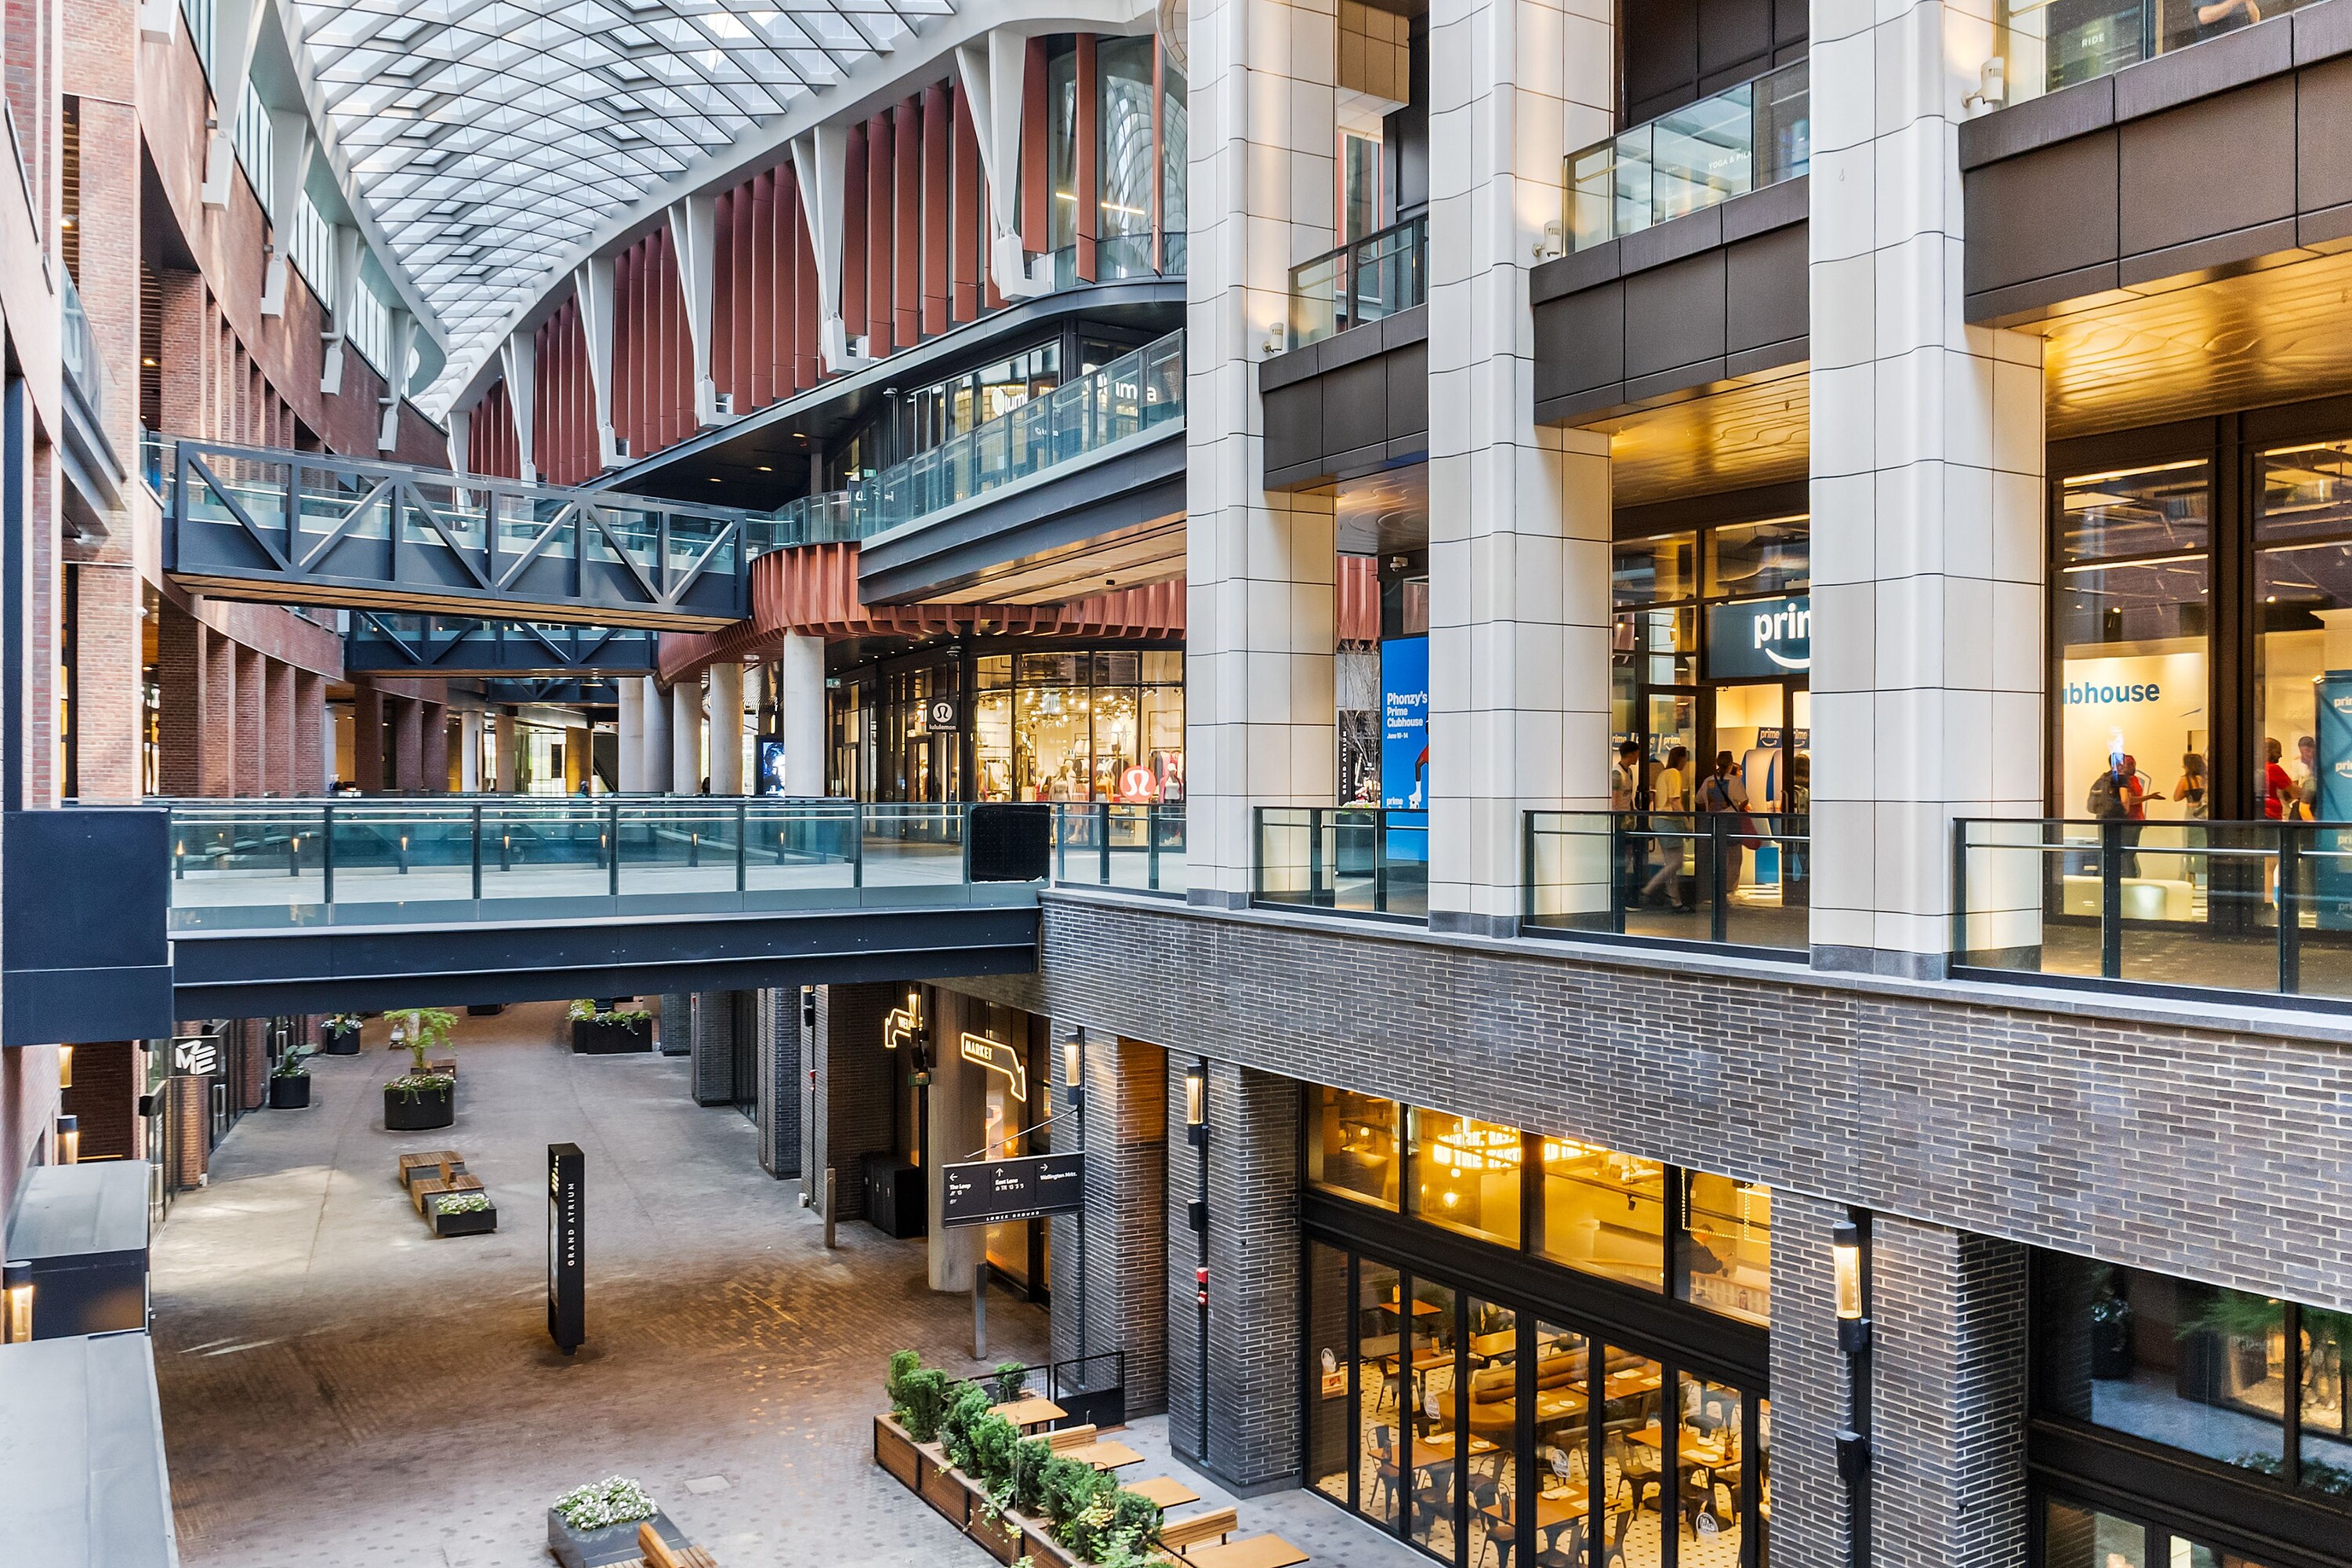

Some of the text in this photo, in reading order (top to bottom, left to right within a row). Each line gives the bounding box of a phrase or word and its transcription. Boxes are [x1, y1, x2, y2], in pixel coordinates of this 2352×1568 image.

[2082, 32, 2105, 48] RIDE
[1709, 158, 1728, 170] YOGA
[1387, 690, 1428, 706] Phonzy's
[1387, 706, 1408, 717] Prime
[1387, 717, 1424, 728] Clubhouse
[1760, 728, 1780, 740] prime
[1386, 796, 1403, 807] prime
[964, 1040, 993, 1061] MARKET
